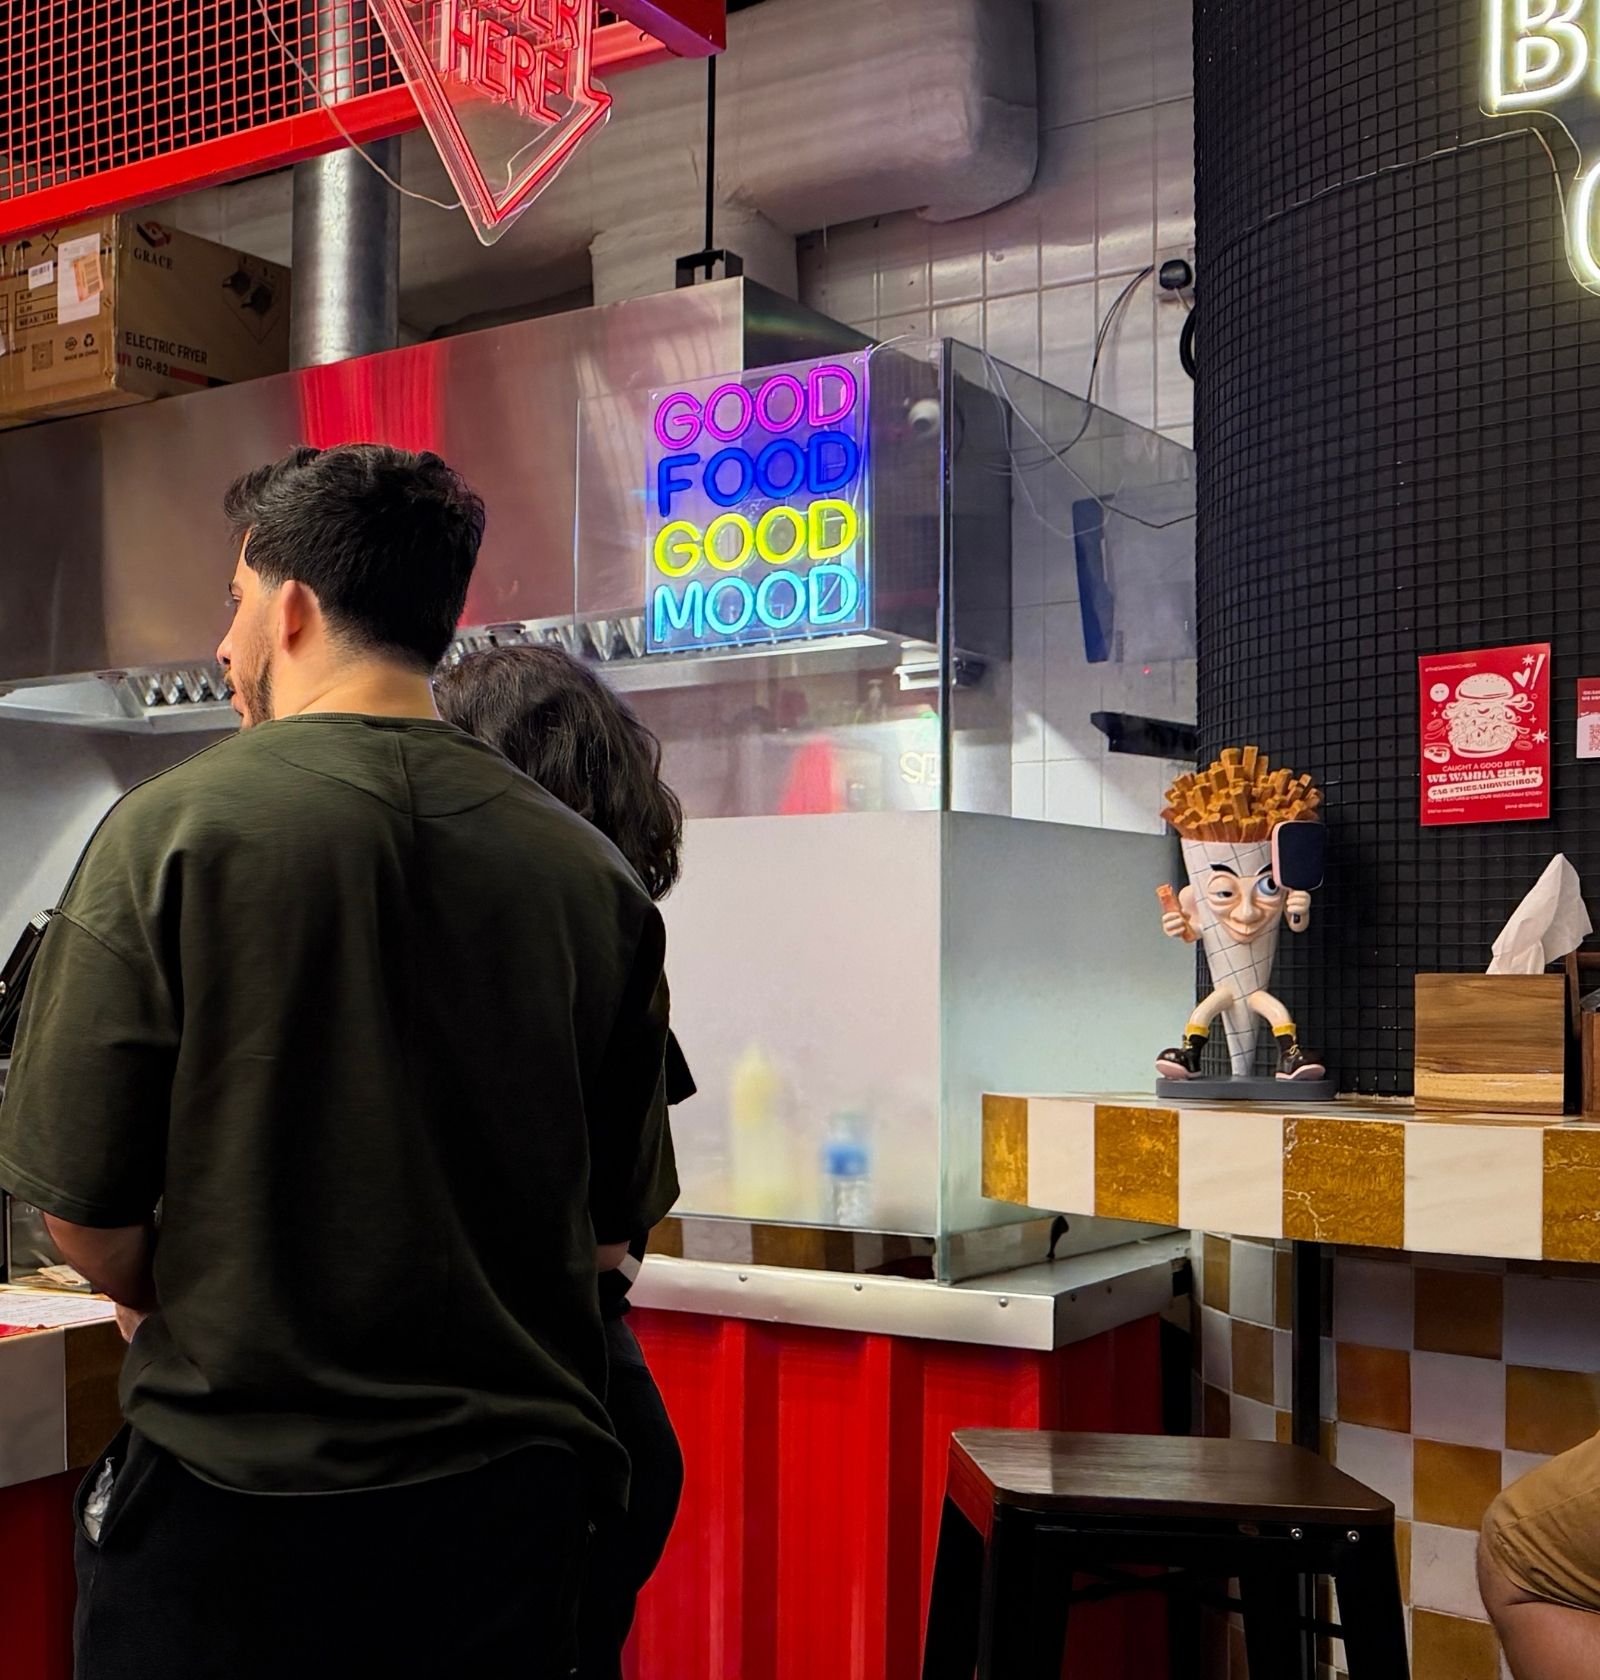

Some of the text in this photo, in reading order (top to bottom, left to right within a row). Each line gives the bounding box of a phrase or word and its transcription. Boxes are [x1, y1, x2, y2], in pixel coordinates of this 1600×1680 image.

[443, 0, 565, 122] HERE
[133, 247, 173, 271] GRACE
[125, 331, 208, 365] ELECTRIC FRYER
[135, 355, 169, 376] GR-82
[654, 364, 858, 450] GOOD
[657, 430, 860, 517] FOOD
[653, 498, 859, 578] GOOD
[653, 564, 859, 643] MOOD
[1427, 773, 1448, 783] WE
[1442, 763, 1472, 773] CAUGHT
[1480, 761, 1503, 769] GOOD
[1504, 759, 1525, 767] BITE?
[1431, 788, 1448, 797] TAG
